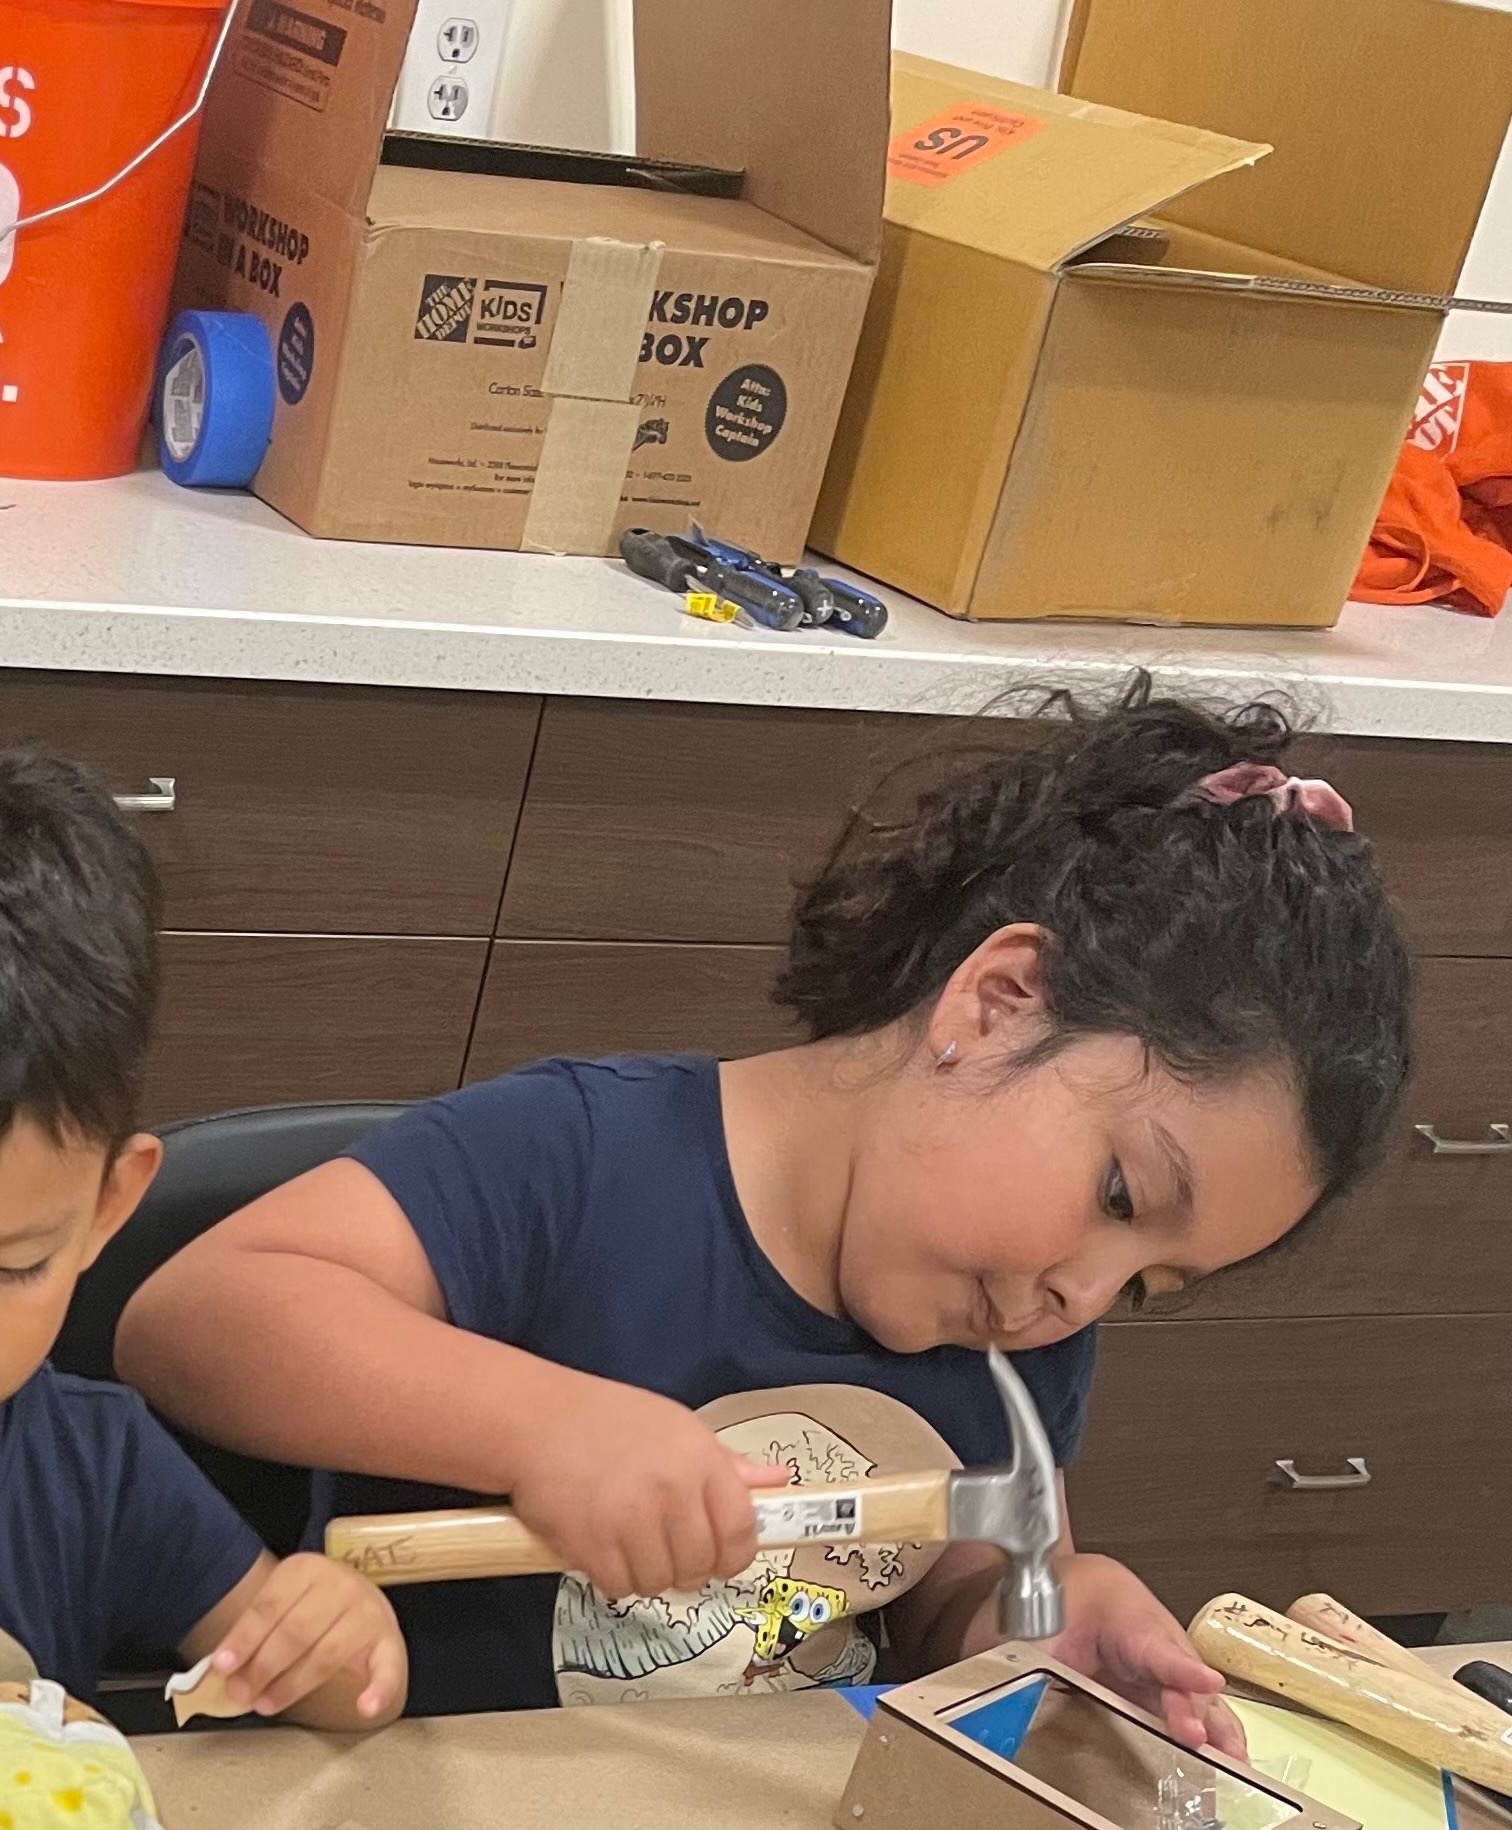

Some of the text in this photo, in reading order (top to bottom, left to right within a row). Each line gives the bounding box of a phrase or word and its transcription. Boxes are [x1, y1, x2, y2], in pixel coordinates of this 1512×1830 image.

[914, 127, 989, 159] US
[249, 250, 282, 298] BOX
[416, 278, 475, 339] HOME
[480, 295, 533, 322] KIDS
[647, 290, 769, 330] KSHOP
[737, 395, 763, 412] Kids
[715, 405, 772, 435] Workshop
[715, 425, 759, 447] Captain
